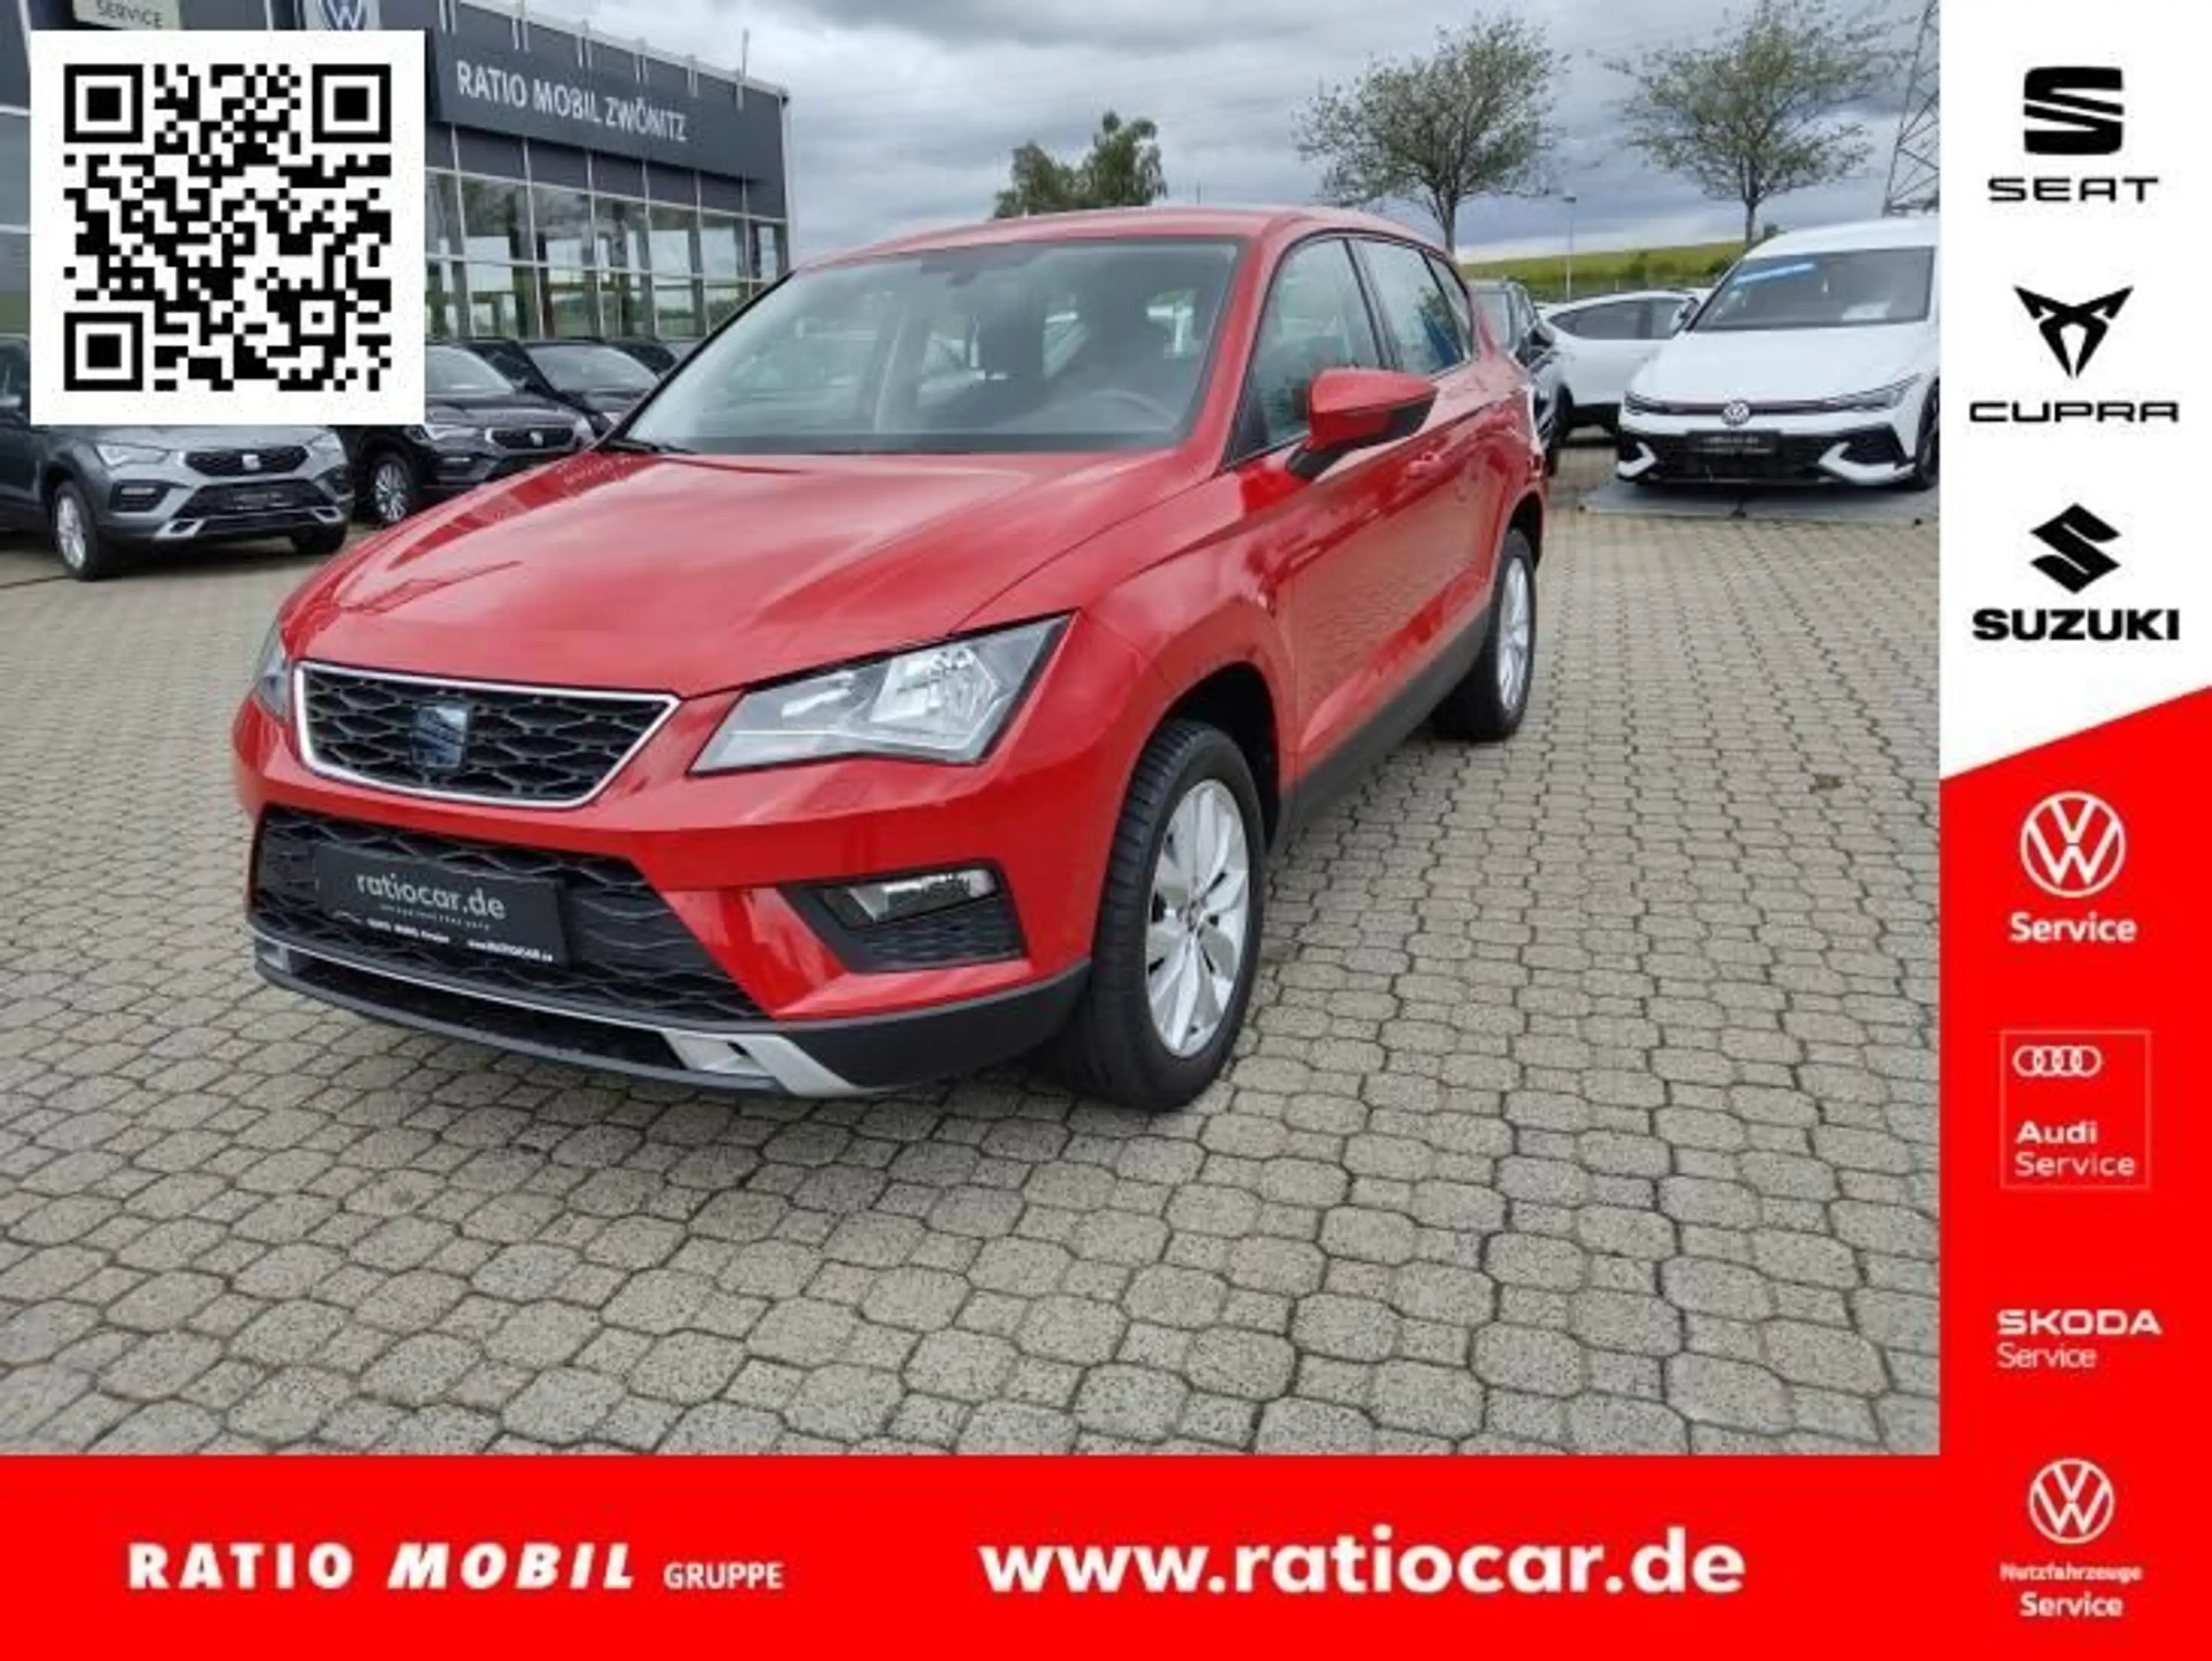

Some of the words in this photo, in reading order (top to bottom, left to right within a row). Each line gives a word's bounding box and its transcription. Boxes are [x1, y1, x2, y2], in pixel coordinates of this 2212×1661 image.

[457, 60, 528, 108] RATIO
[533, 78, 603, 123] MOBIL
[604, 95, 689, 143] ZWÖNITZ
[355, 872, 506, 920] ratiocar.de
